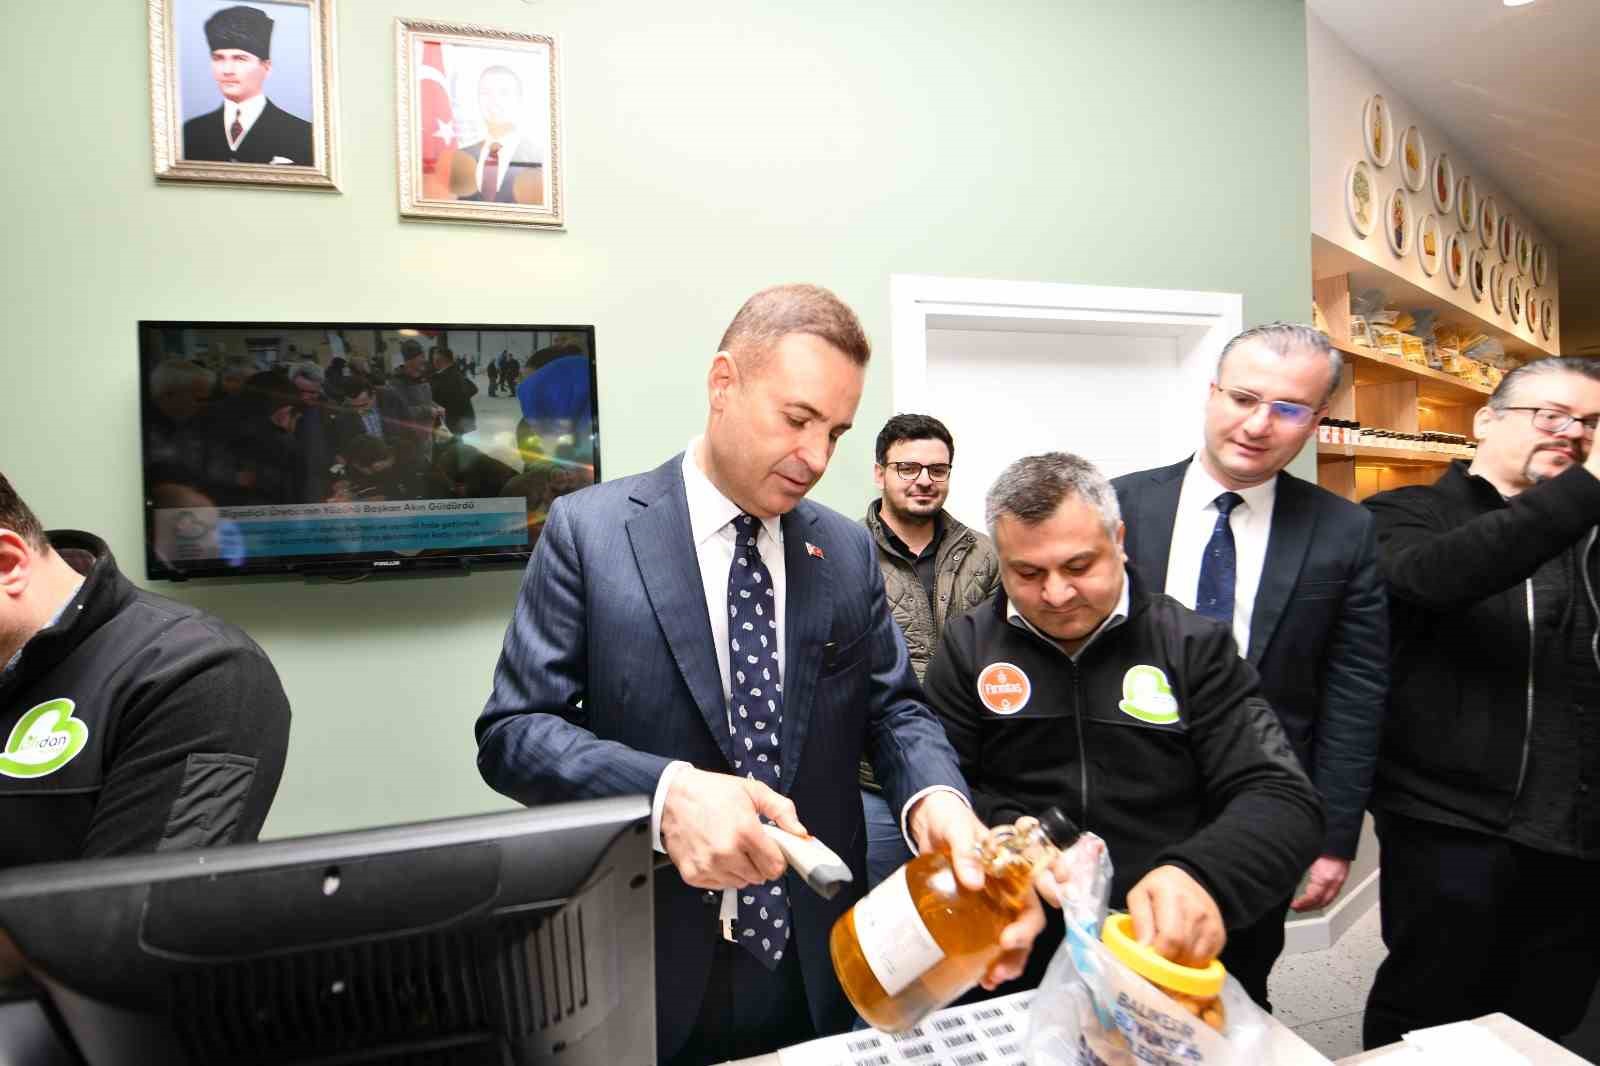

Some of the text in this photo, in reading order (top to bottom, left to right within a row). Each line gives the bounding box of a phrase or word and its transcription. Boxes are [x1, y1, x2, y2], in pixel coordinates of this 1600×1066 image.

[363, 504, 401, 514] Başkan
[404, 503, 426, 512] Akın
[428, 501, 474, 511] Güldürdü
